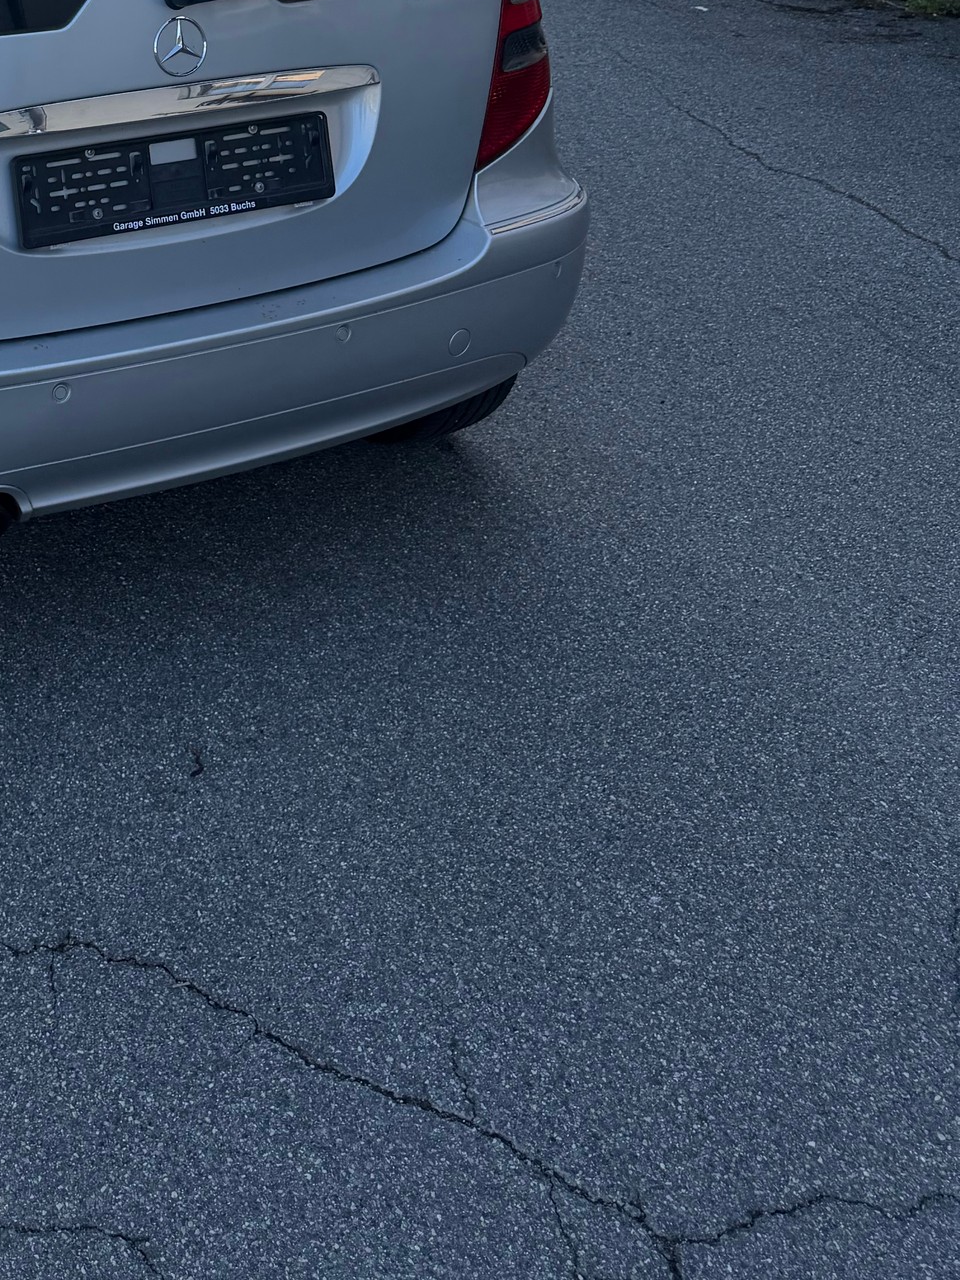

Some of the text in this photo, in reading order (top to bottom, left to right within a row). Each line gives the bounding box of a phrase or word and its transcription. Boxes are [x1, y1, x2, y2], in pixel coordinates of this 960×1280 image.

[113, 200, 256, 231] Garage Simmen GmbH 5033 Buchs
